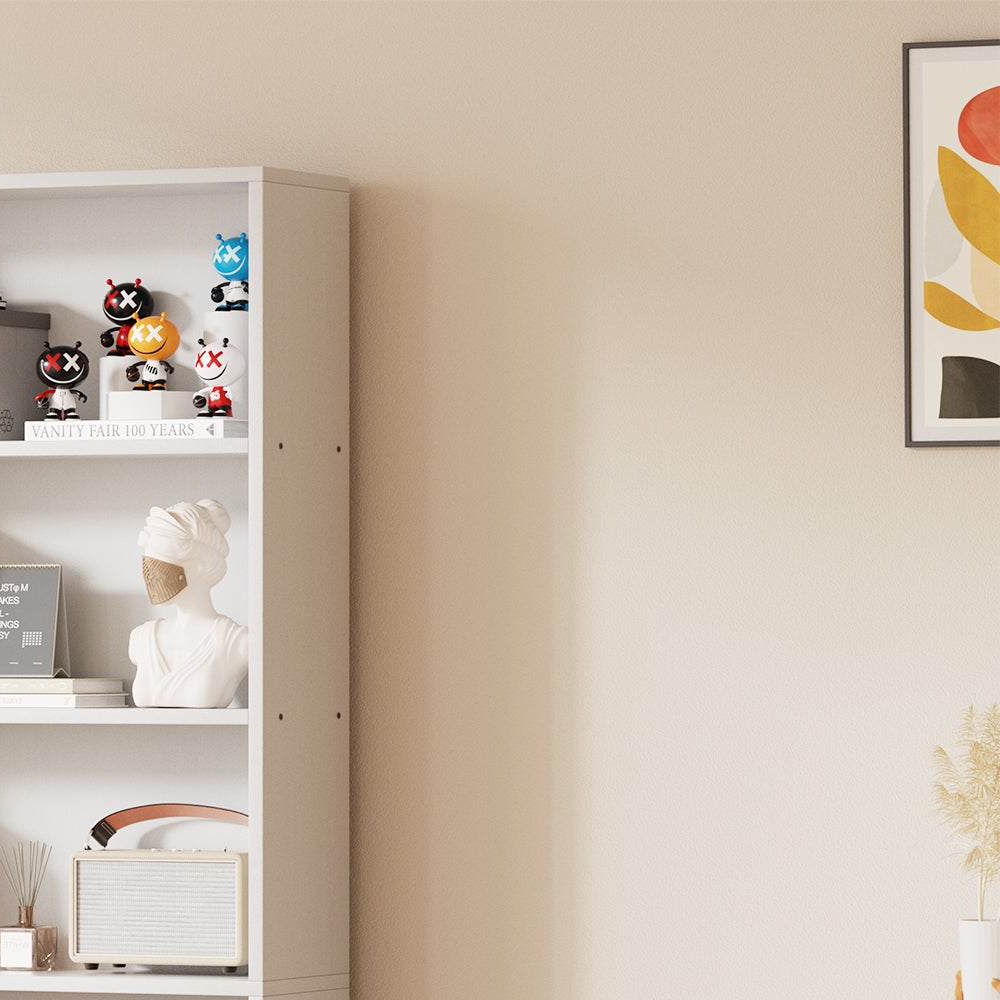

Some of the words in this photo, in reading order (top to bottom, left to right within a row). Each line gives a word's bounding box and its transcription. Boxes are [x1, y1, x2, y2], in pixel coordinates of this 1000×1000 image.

[32, 424, 89, 438] VANITY
[90, 423, 120, 437] FAIR
[125, 423, 146, 437] 100
[150, 422, 194, 437] YEARS
